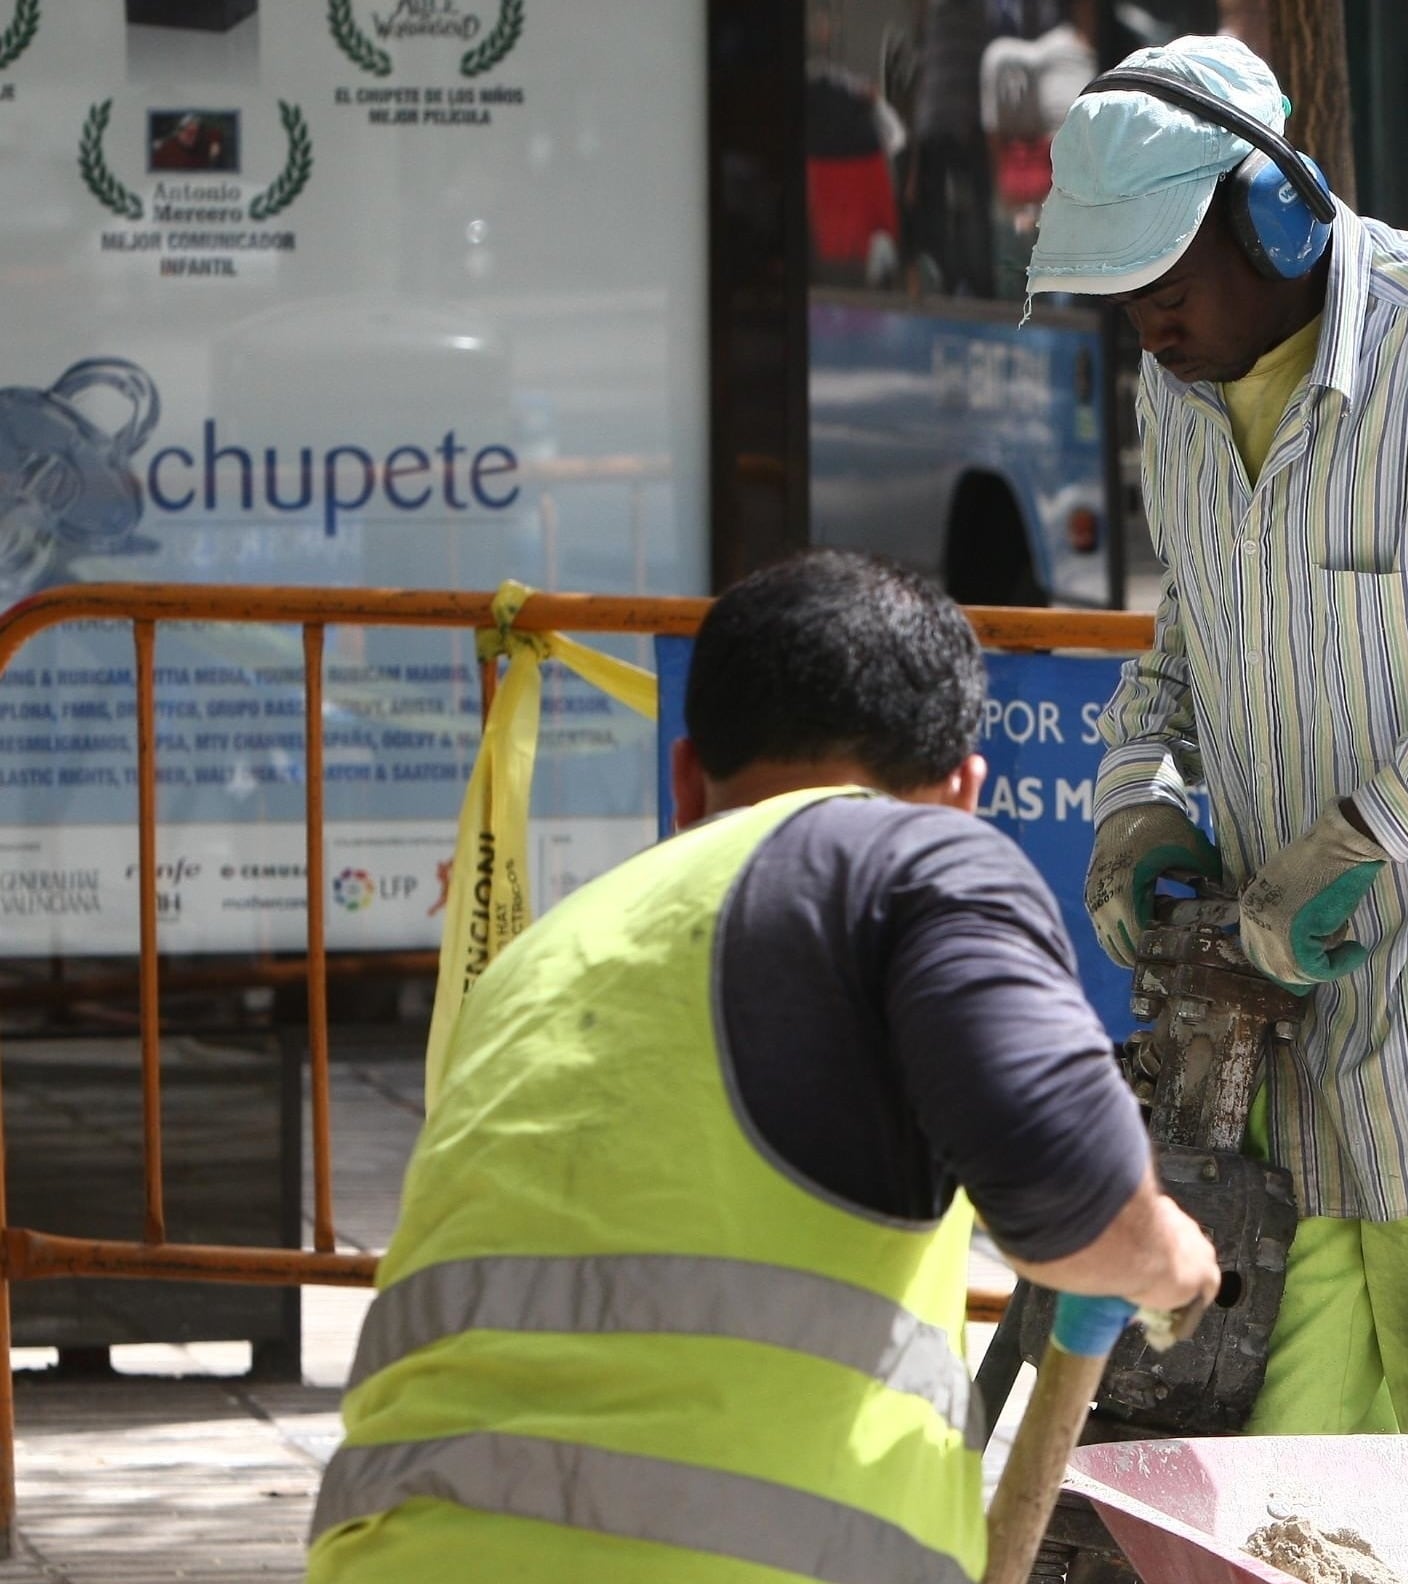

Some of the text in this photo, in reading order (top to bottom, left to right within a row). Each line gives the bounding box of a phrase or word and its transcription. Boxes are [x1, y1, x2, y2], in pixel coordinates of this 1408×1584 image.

[335, 88, 350, 104] EL
[424, 88, 441, 104] DE
[369, 108, 418, 125] MEJOR
[154, 182, 241, 201] Antonio
[153, 205, 242, 223] Mercero
[101, 231, 295, 250] MEJOR COMUNICADOR
[160, 257, 237, 277] INFANTIL
[146, 419, 520, 536] chupete
[125, 857, 201, 885] rnfe
[379, 876, 417, 899] LFP
